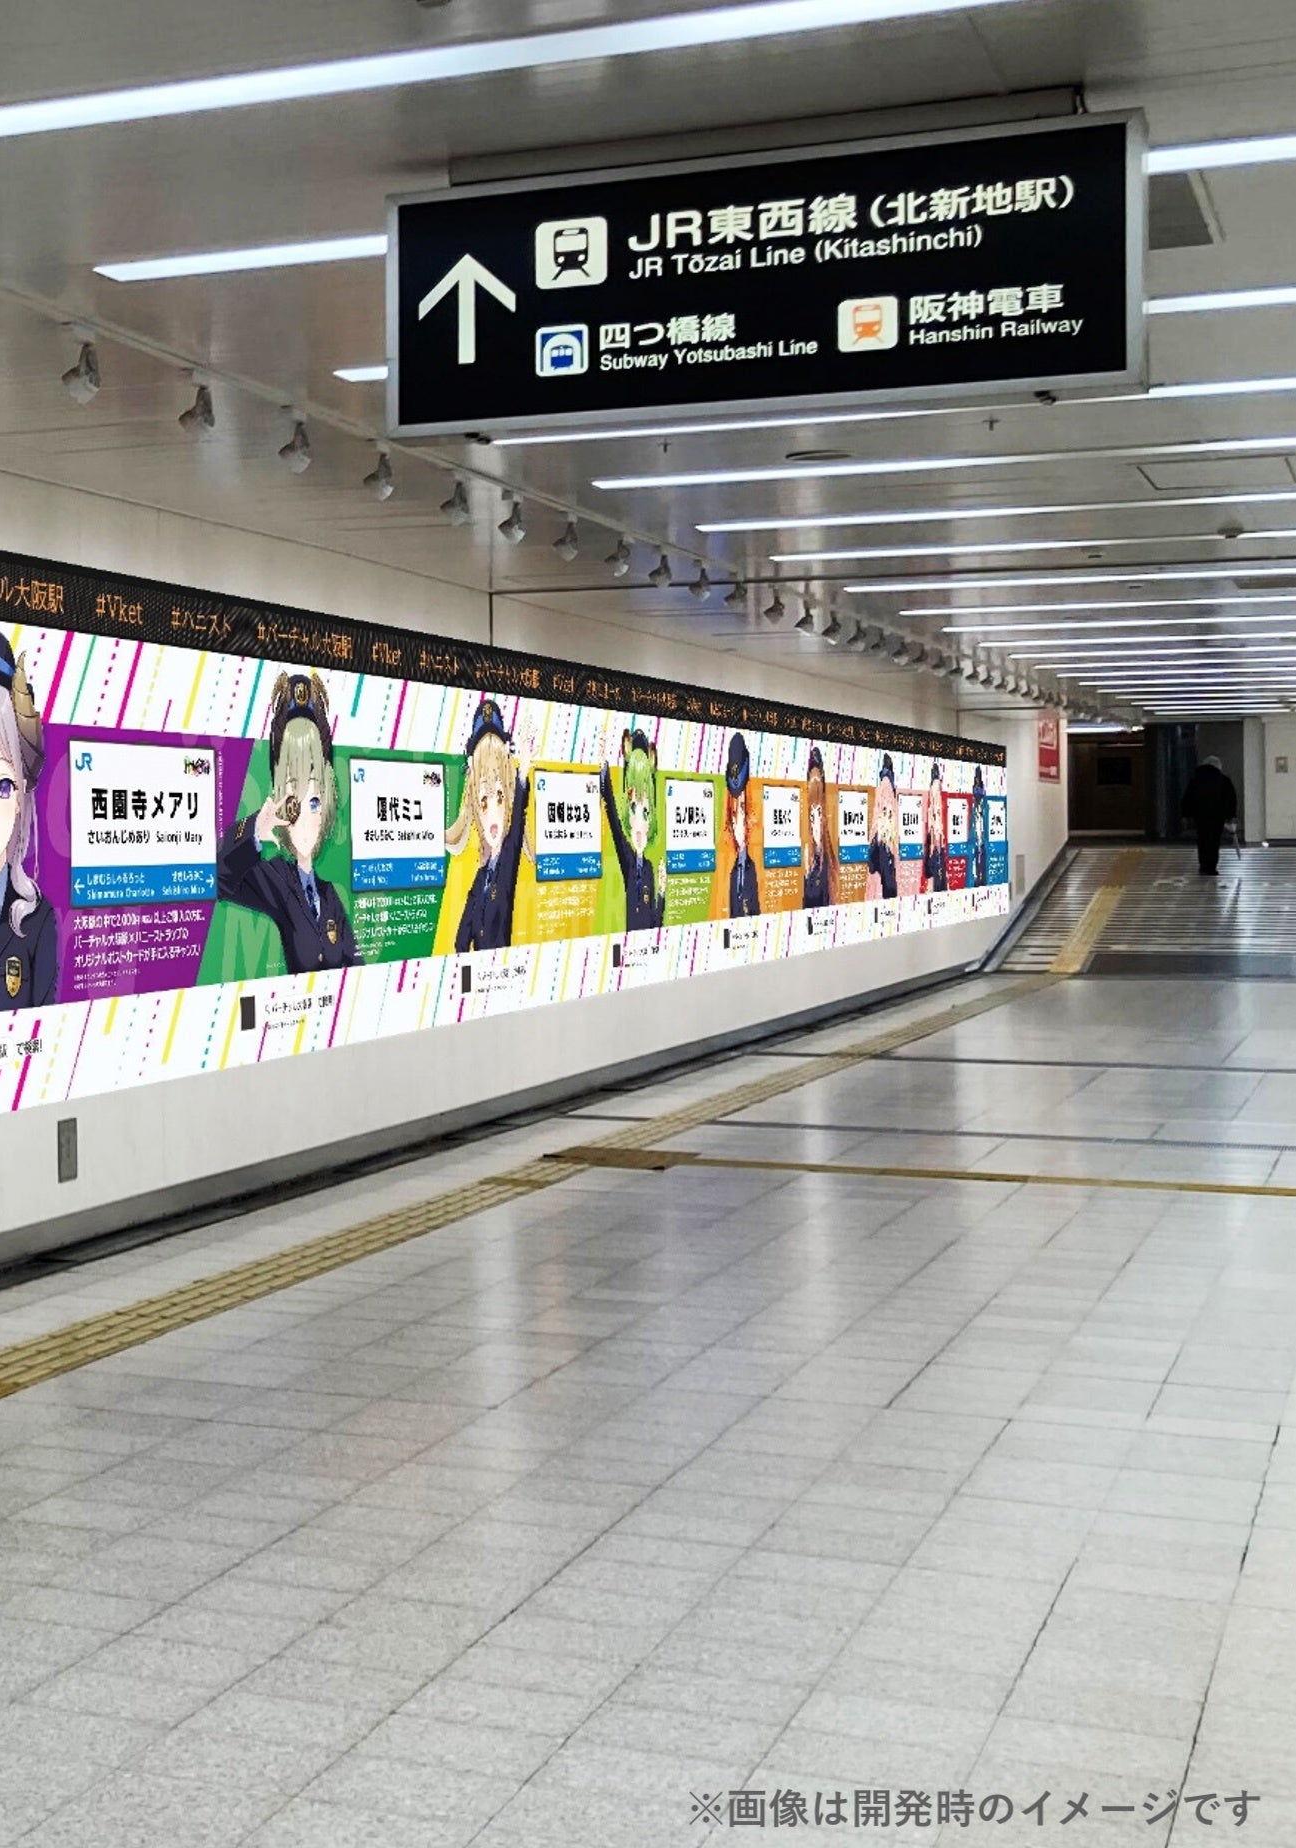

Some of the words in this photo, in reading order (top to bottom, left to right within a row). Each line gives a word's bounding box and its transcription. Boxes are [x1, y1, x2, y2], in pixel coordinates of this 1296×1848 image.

[627, 194, 857, 252] JR東西線
[869, 174, 1076, 229] (北新地駅)
[628, 255, 663, 280] JR
[671, 247, 742, 274] Tōzai
[750, 244, 806, 269] Line
[814, 223, 984, 264] (Kitashinchi)
[909, 283, 1065, 325] 阪神電車
[599, 312, 737, 352] 四つ橋線
[909, 325, 994, 347] Hanshin
[1000, 316, 1084, 339] Railway
[599, 350, 668, 373] Subway
[673, 341, 774, 367] Yotsubashi
[778, 338, 819, 360] Line
[75, 752, 93, 771] JR
[91, 787, 199, 820] 西園寺メアリ
